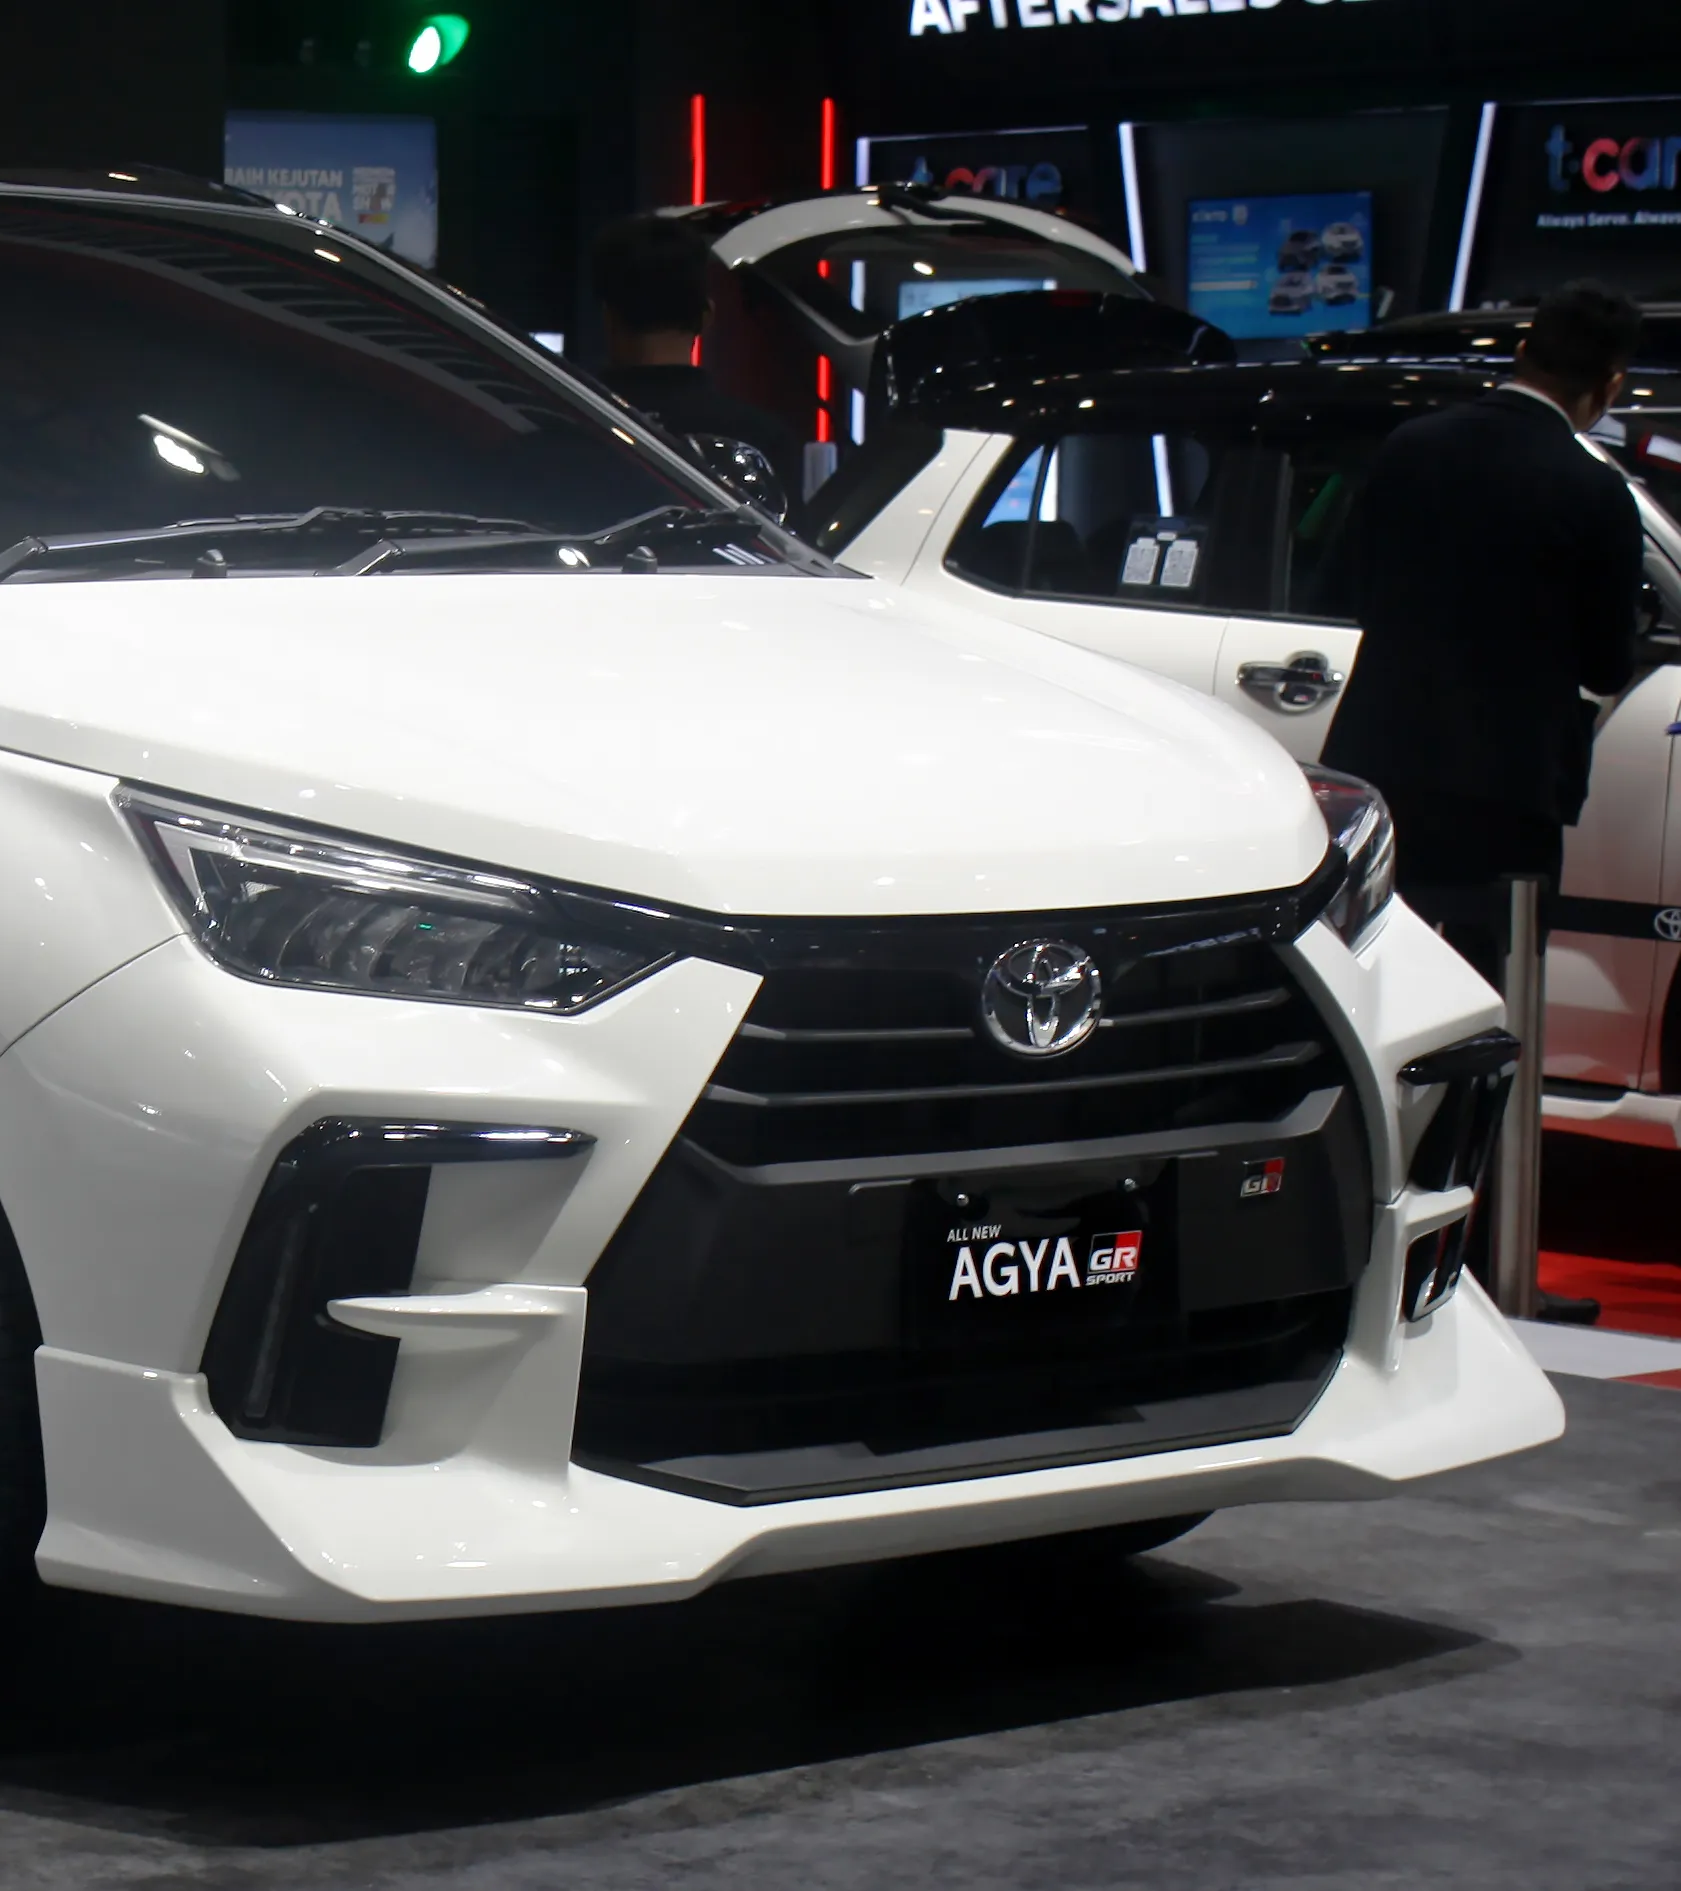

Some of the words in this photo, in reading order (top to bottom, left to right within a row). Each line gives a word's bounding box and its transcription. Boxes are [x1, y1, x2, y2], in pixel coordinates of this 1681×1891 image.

[909, 0, 1282, 36] AFTERS
[947, 1229, 969, 1242] ALL
[971, 1224, 1002, 1240] NEW
[948, 1236, 1081, 1301] AGYA
[1088, 1246, 1137, 1273] GR
[1085, 1271, 1135, 1287] SPORT
